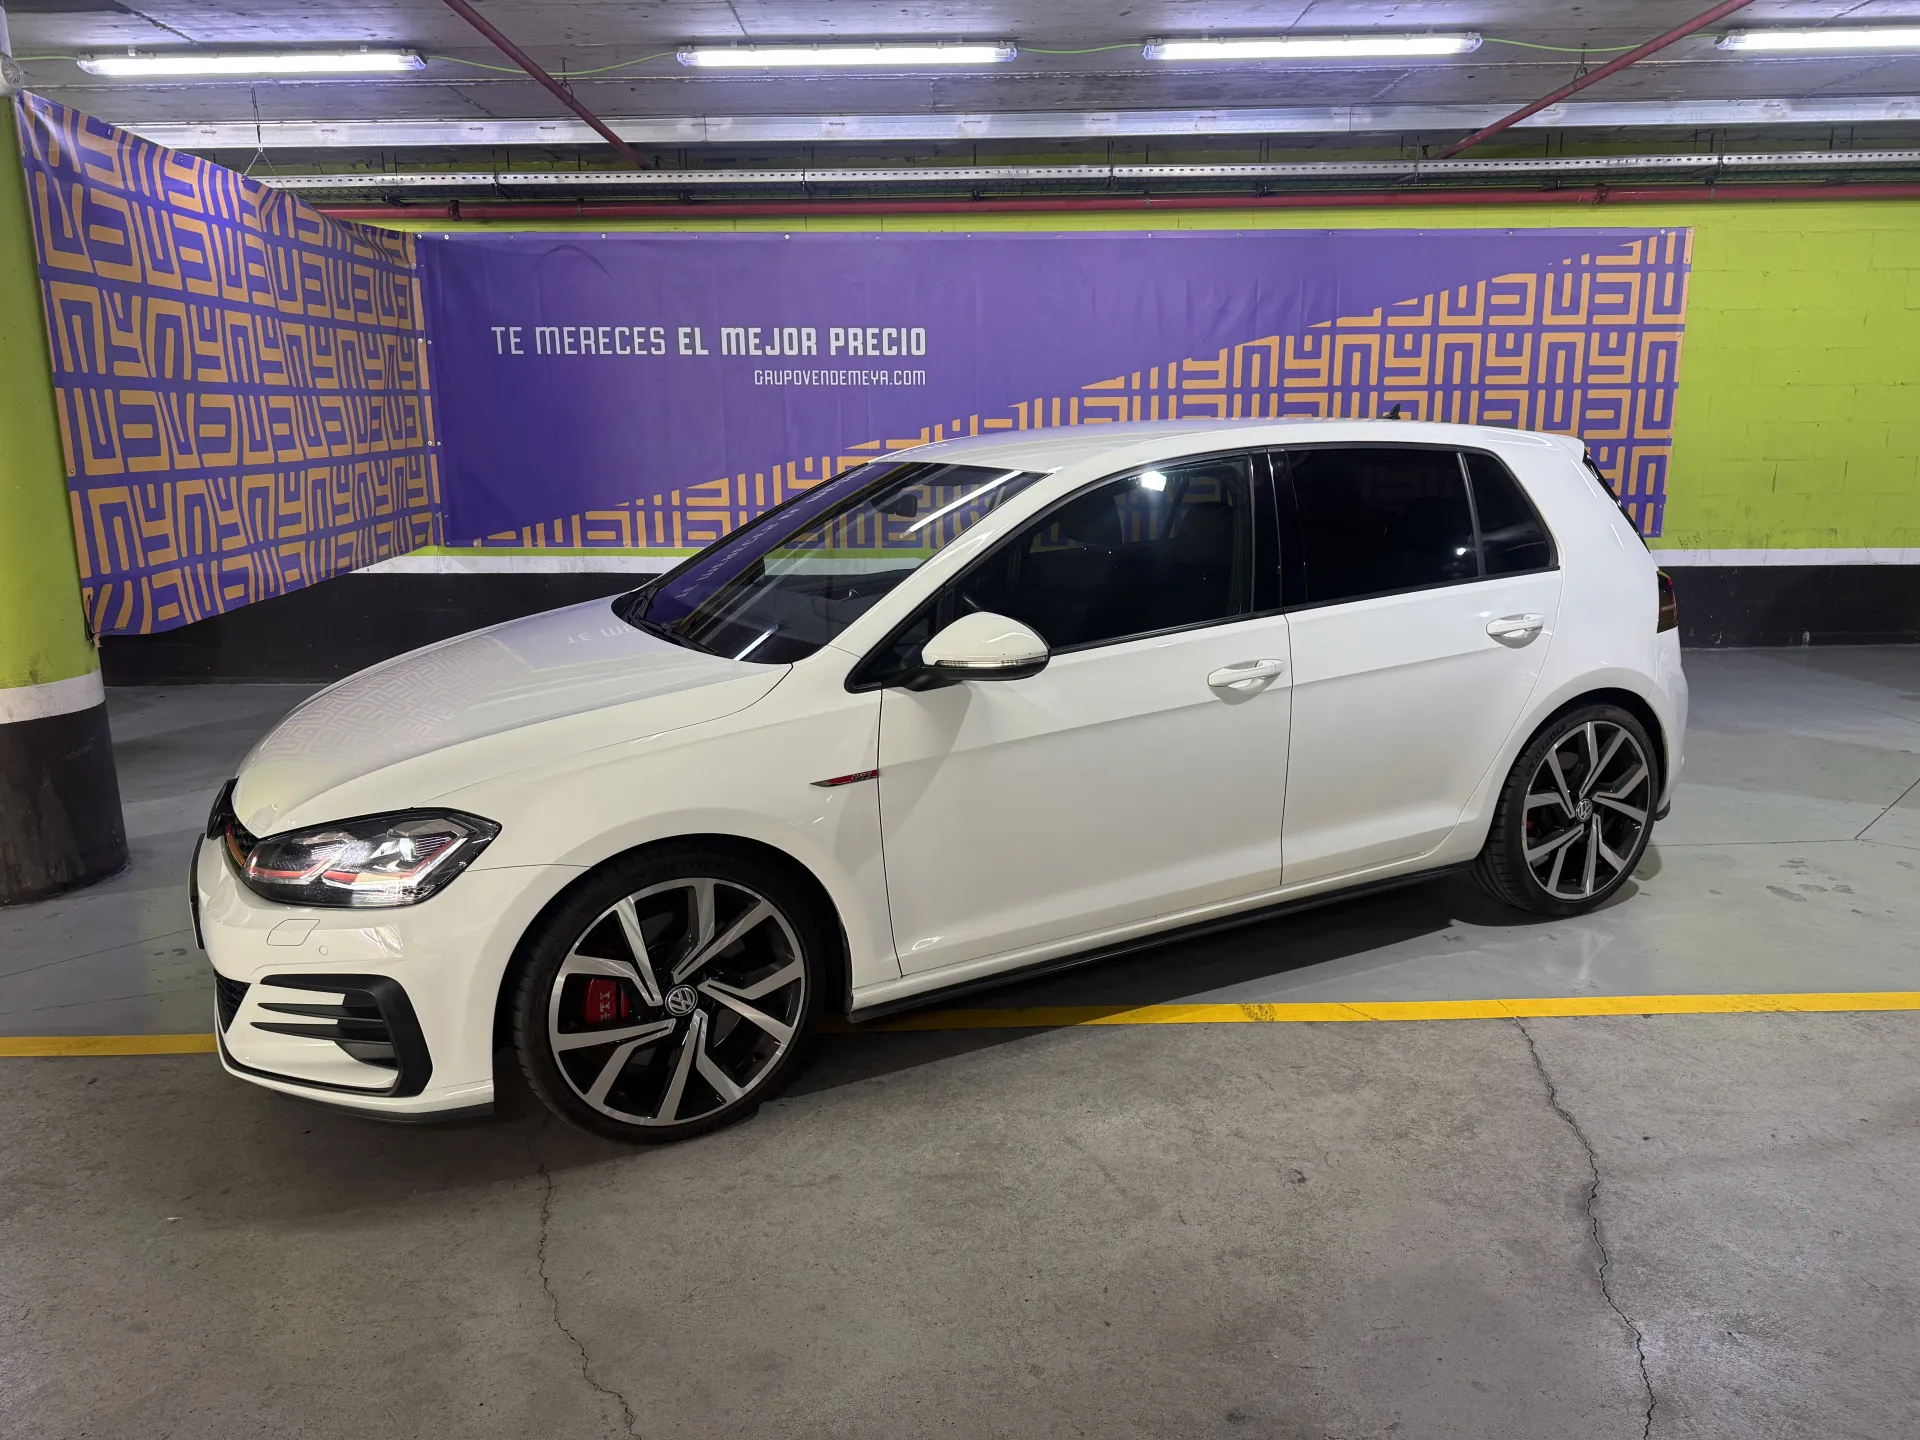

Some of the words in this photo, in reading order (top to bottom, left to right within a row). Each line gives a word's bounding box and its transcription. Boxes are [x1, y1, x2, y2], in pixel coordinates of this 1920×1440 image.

[491, 326, 524, 355] TE
[535, 326, 666, 355] MERECES
[677, 326, 710, 356] EL
[720, 327, 818, 356] MEJOR
[829, 327, 926, 356] PRECIO
[754, 369, 926, 386] GRUPOVENDEMEYA.COM
